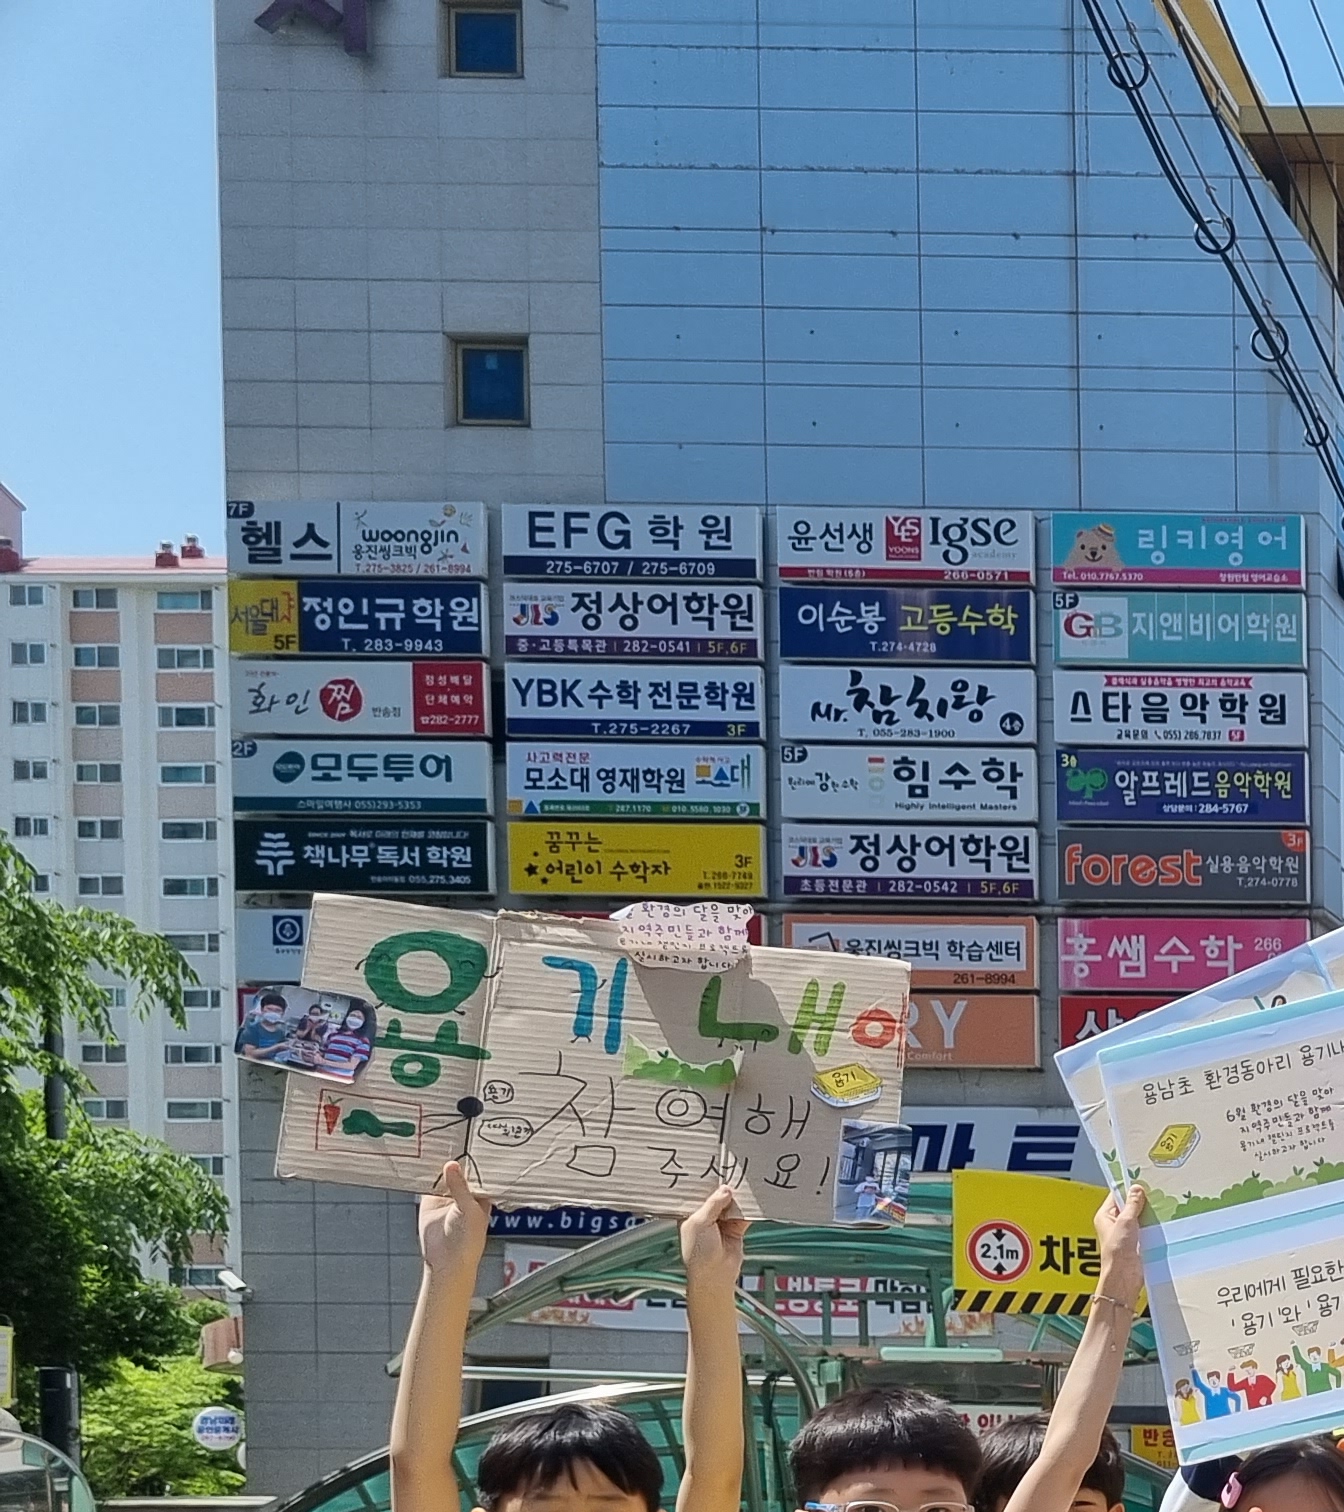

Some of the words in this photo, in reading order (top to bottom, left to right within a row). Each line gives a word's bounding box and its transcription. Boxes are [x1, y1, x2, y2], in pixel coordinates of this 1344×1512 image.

[227, 503, 249, 517] 7F
[362, 529, 459, 555] woongjin
[528, 511, 632, 550] EFG
[787, 520, 873, 555] 윤선생
[929, 516, 1019, 566] Igse
[352, 544, 417, 561] 웅진씽크빅
[1138, 525, 1287, 566] 링키영어
[546, 561, 620, 575] 275-6707
[642, 561, 716, 576] 275-6709
[943, 570, 1010, 581] 266-0571
[302, 597, 479, 632] 정인규학원
[512, 603, 560, 626] JLS
[570, 591, 755, 632] 정상어학원
[797, 600, 887, 635] 이순봉
[898, 603, 1019, 636] 고등수학
[1131, 612, 1298, 642] 지앤비어학원
[274, 634, 297, 650] 5F
[364, 638, 444, 652] 283-9943
[623, 640, 691, 653] 282-0541
[512, 678, 584, 708] YBK
[587, 680, 641, 709] 수학
[648, 680, 756, 711] 전문학원
[811, 701, 848, 722] Mr.
[846, 669, 997, 726] 참치왕
[372, 706, 402, 718] 반송점
[1069, 691, 1287, 725] 스타음악학원
[592, 723, 691, 735] T.275-2267
[727, 724, 746, 736] 3F
[872, 728, 956, 738] 055-283-1900
[311, 753, 453, 783] 모두투어
[527, 752, 591, 764] 사고력전문
[524, 767, 590, 792] 모소대
[596, 767, 686, 794] 영재학원
[1114, 770, 1211, 806] 알프레드
[1214, 770, 1292, 799] 음악학원
[895, 802, 924, 811] Highly
[928, 802, 976, 811] Intelligent
[980, 803, 1017, 811] Masters
[1198, 803, 1249, 814] 284-5767
[545, 831, 603, 854] 꿈꾸는
[849, 833, 1031, 873] 정상어학원
[303, 844, 371, 868] 책나무
[376, 845, 420, 868] 독서
[426, 846, 473, 868] 학원
[735, 855, 752, 868] 3F
[1065, 844, 1202, 886] forest
[1205, 855, 1299, 874] 실용음악학원
[545, 860, 602, 884] 어린이
[609, 860, 672, 883] 수학자
[1236, 876, 1298, 888] T.274-0778
[800, 879, 868, 893] 초등전문관
[888, 880, 958, 894] 282-0542
[946, 939, 1021, 962] 학습센터
[1060, 933, 1243, 978] 홍쌤수학
[953, 973, 1016, 985] 261-8994
[1142, 1075, 1195, 1105] 용남초
[1203, 1052, 1293, 1091] 환경동아리
[1226, 1107, 1248, 1123] 6월
[980, 1242, 1019, 1261] 2.1m
[1217, 1275, 1287, 1307] 우리에게
[1291, 1259, 1344, 1291] 필요한
